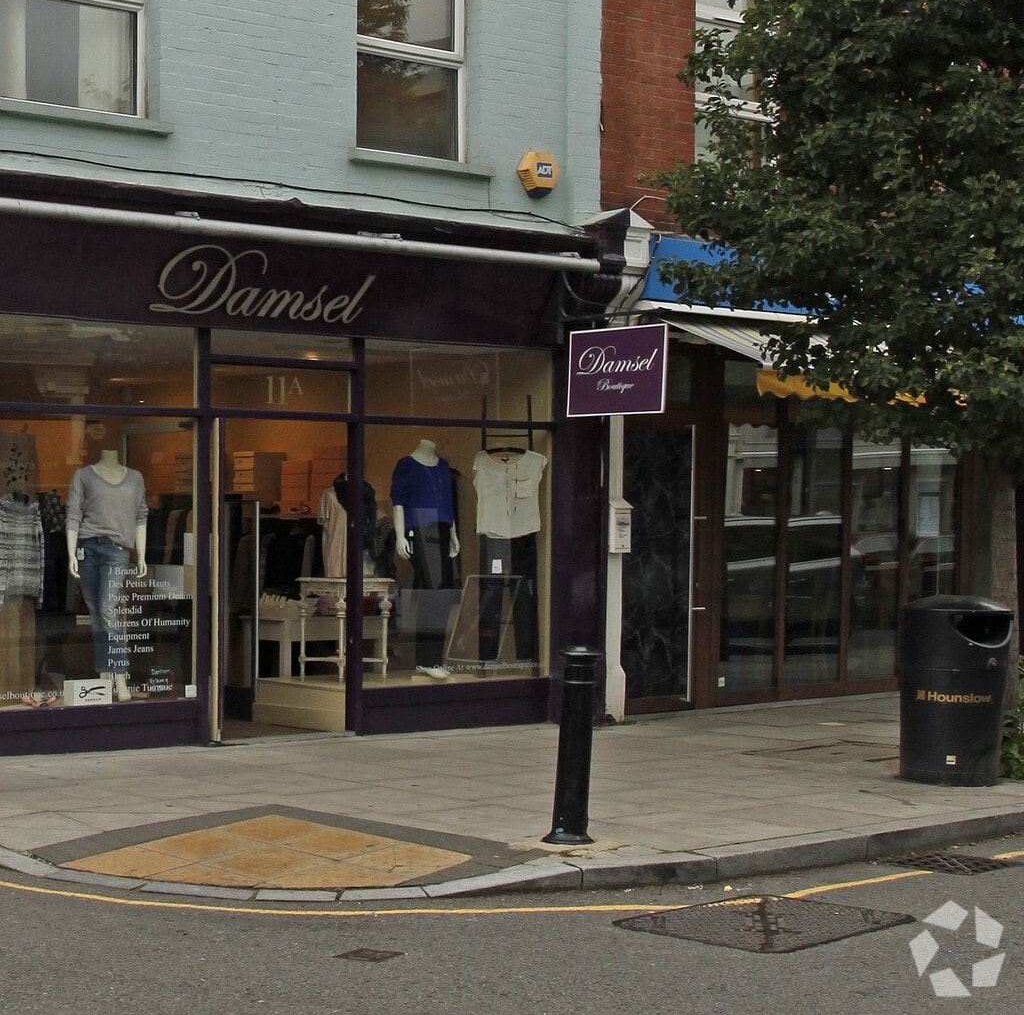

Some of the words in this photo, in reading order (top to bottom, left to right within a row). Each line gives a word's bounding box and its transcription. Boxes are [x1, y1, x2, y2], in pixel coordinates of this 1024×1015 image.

[537, 165, 553, 175] ADT
[149, 244, 376, 324] Damsel
[576, 346, 658, 375] Damsel
[596, 378, 635, 394] Boutique
[108, 566, 112, 575] J
[115, 567, 139, 575] Brand
[108, 580, 123, 589] Des
[125, 580, 147, 588] Petits
[148, 579, 171, 587] Hauts
[108, 593, 130, 603] Paige
[131, 592, 166, 601] Premium
[108, 605, 143, 616] Splendid
[108, 619, 139, 628] Citizens
[141, 618, 153, 627] Of
[153, 618, 191, 627] Humanity
[108, 632, 150, 642] Equipment
[108, 645, 131, 654] James
[133, 645, 154, 654] Jeans
[108, 658, 130, 669] Pyrus
[927, 690, 992, 704] Hounslow
